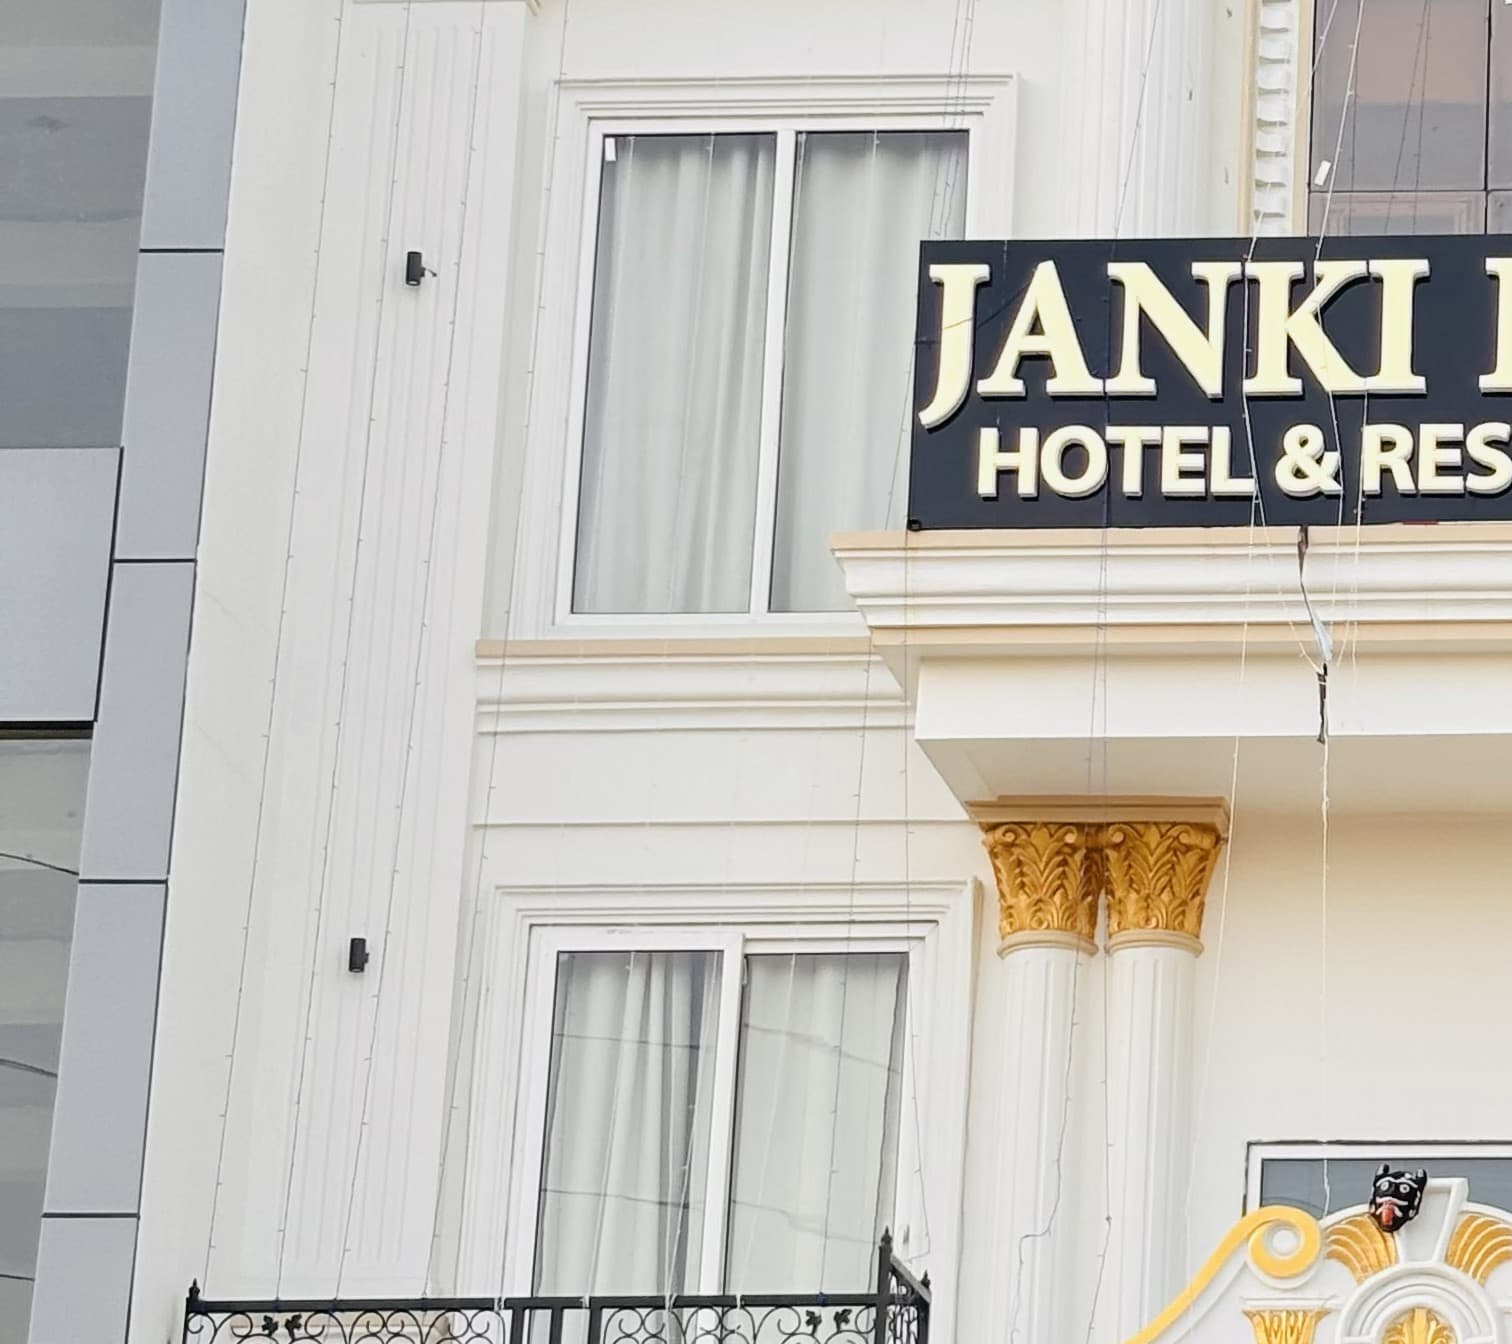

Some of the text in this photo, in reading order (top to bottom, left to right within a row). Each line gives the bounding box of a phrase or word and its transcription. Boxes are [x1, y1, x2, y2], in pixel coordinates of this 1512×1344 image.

[918, 259, 1430, 429] JANKI
[976, 425, 1257, 499] HOTEL
[1274, 423, 1343, 498] &
